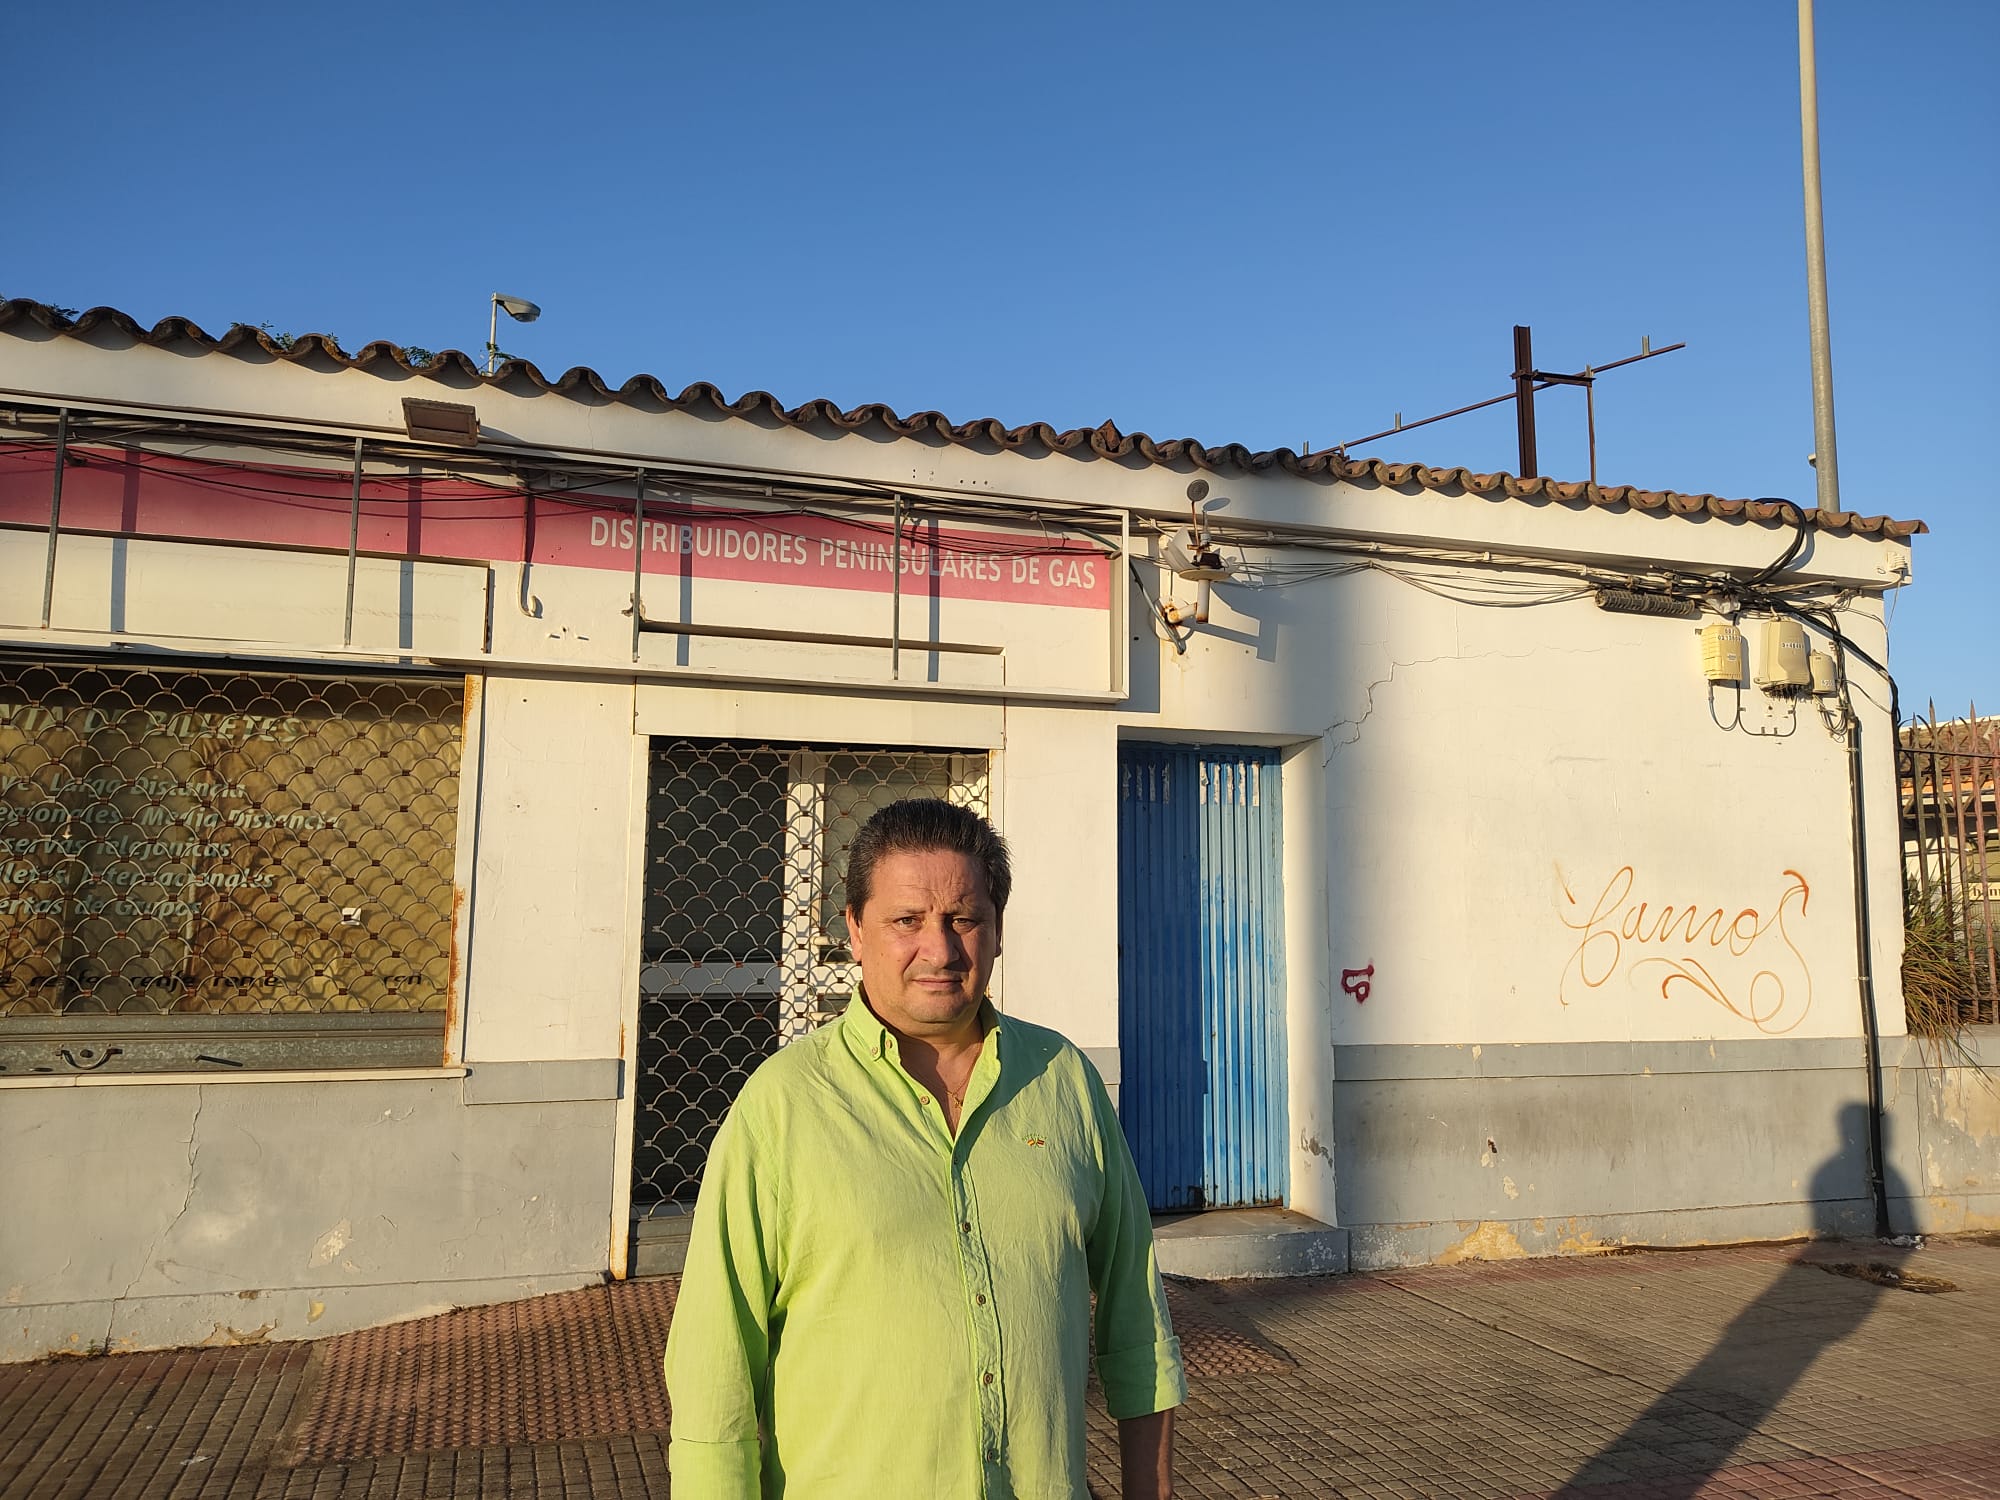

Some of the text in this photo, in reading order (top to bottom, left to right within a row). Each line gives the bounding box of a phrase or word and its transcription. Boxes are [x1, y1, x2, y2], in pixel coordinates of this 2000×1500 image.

[590, 516, 1096, 590] DISTRIBUIDORES PENINSULARES DE GAS
